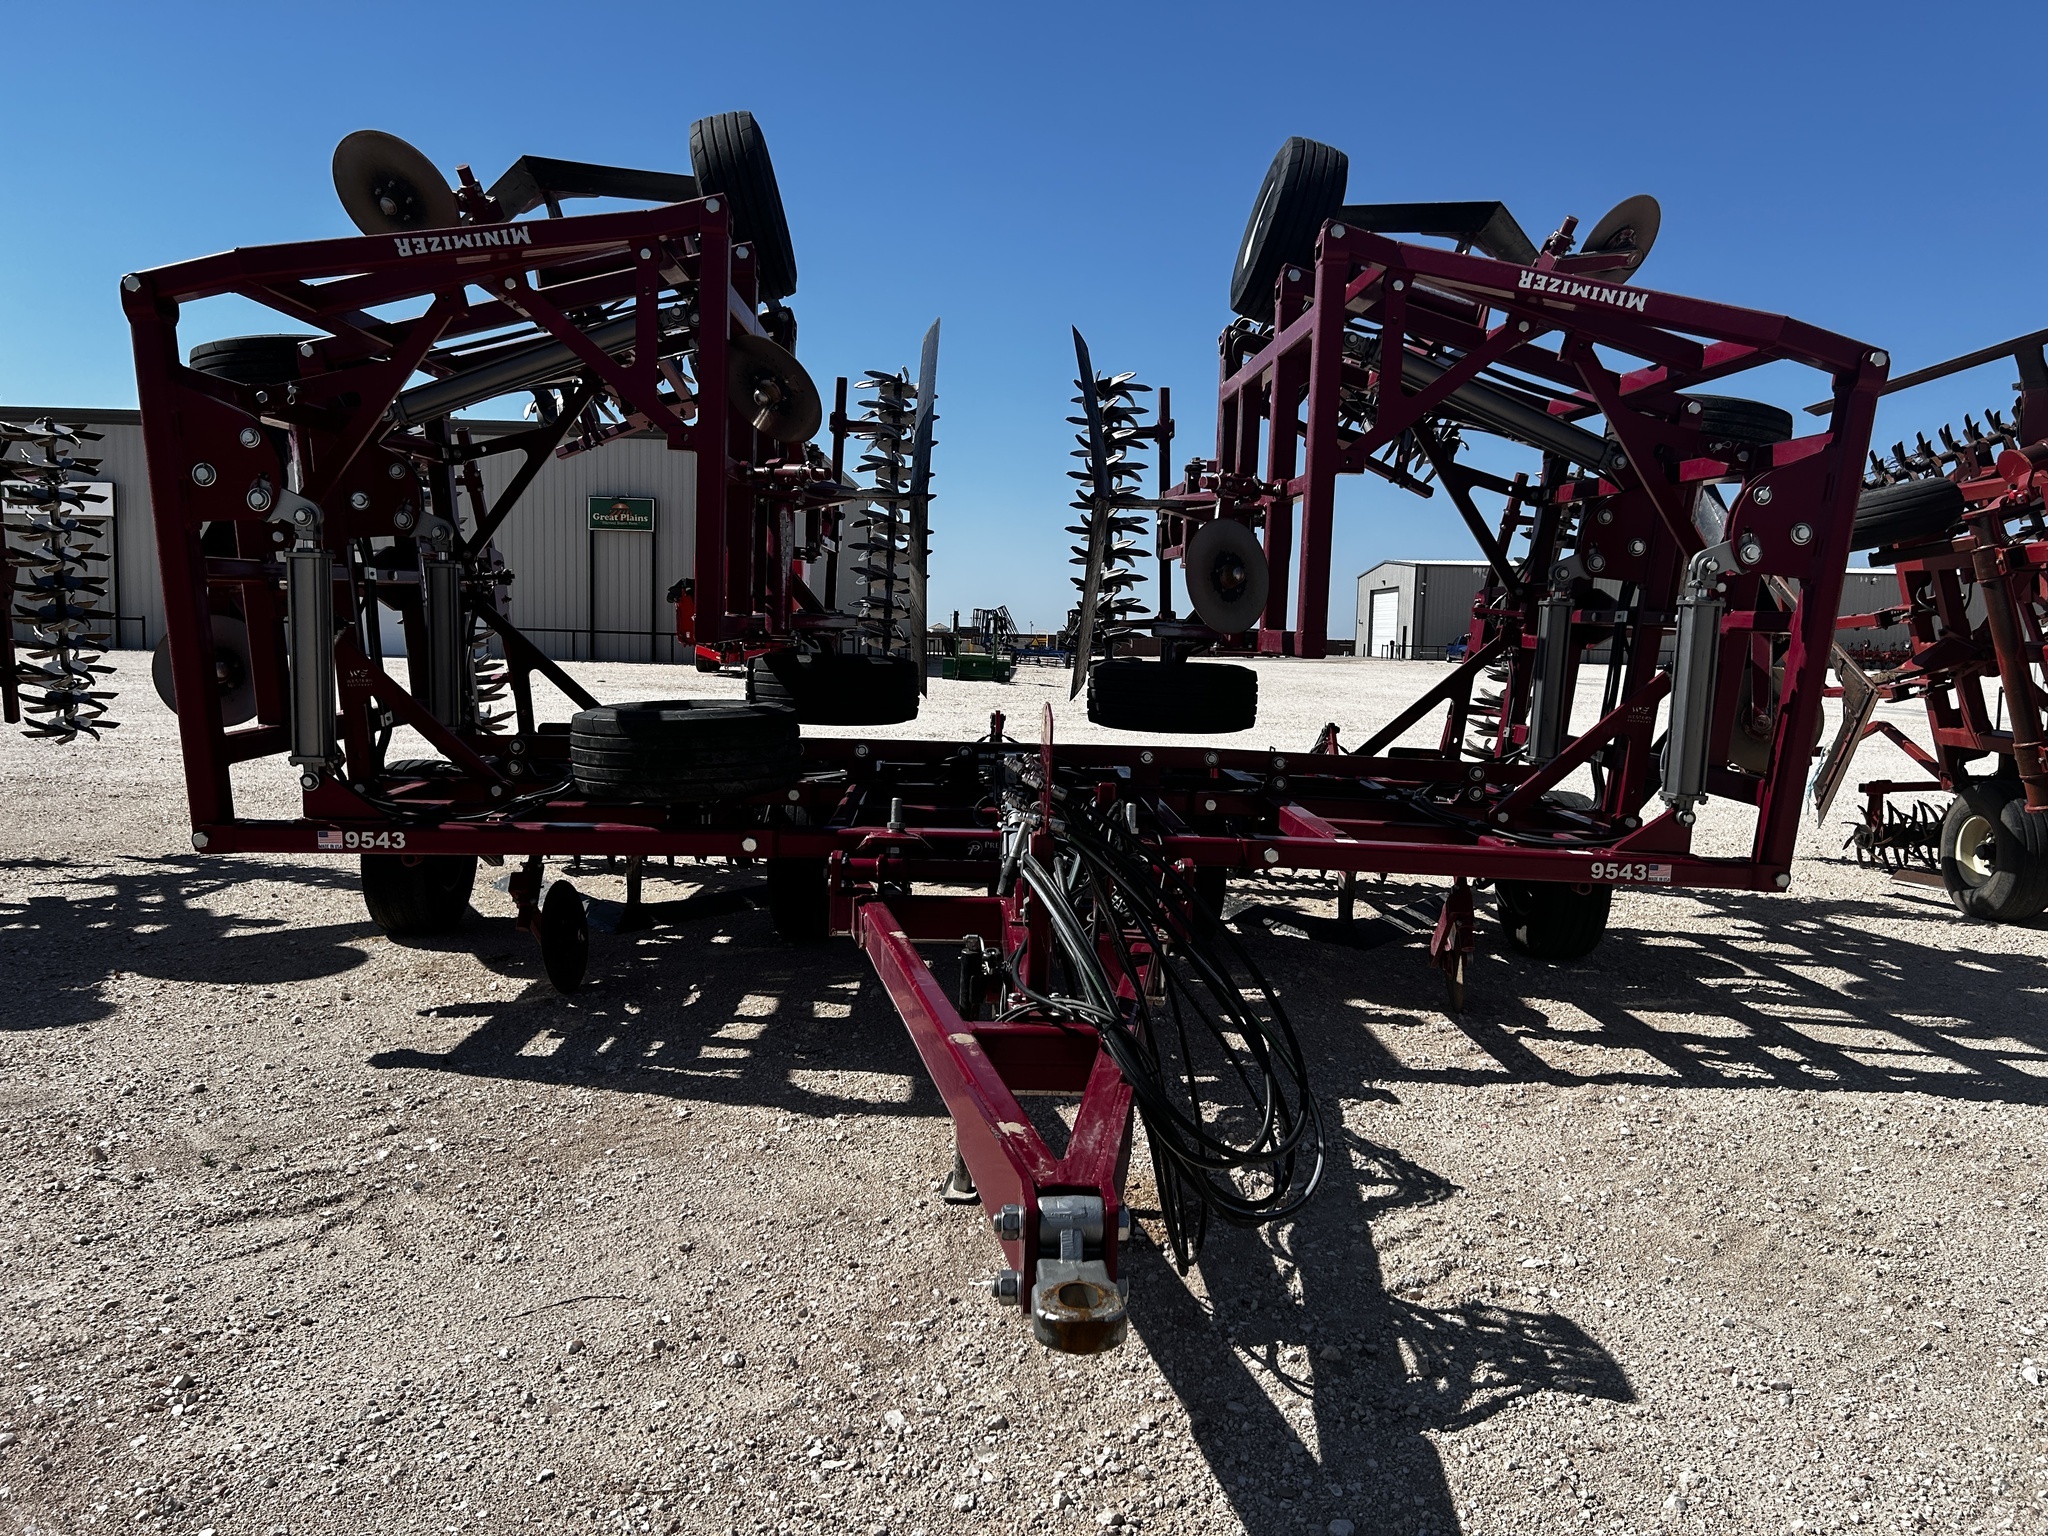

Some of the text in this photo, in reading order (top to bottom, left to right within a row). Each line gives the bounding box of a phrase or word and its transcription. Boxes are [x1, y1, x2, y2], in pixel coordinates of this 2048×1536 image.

[394, 225, 532, 257] MINIMIZER
[1518, 270, 1649, 312] MINIMIZER
[592, 512, 648, 522] Great Plains
[345, 831, 406, 849] 9543
[1591, 862, 1647, 881] 9543
